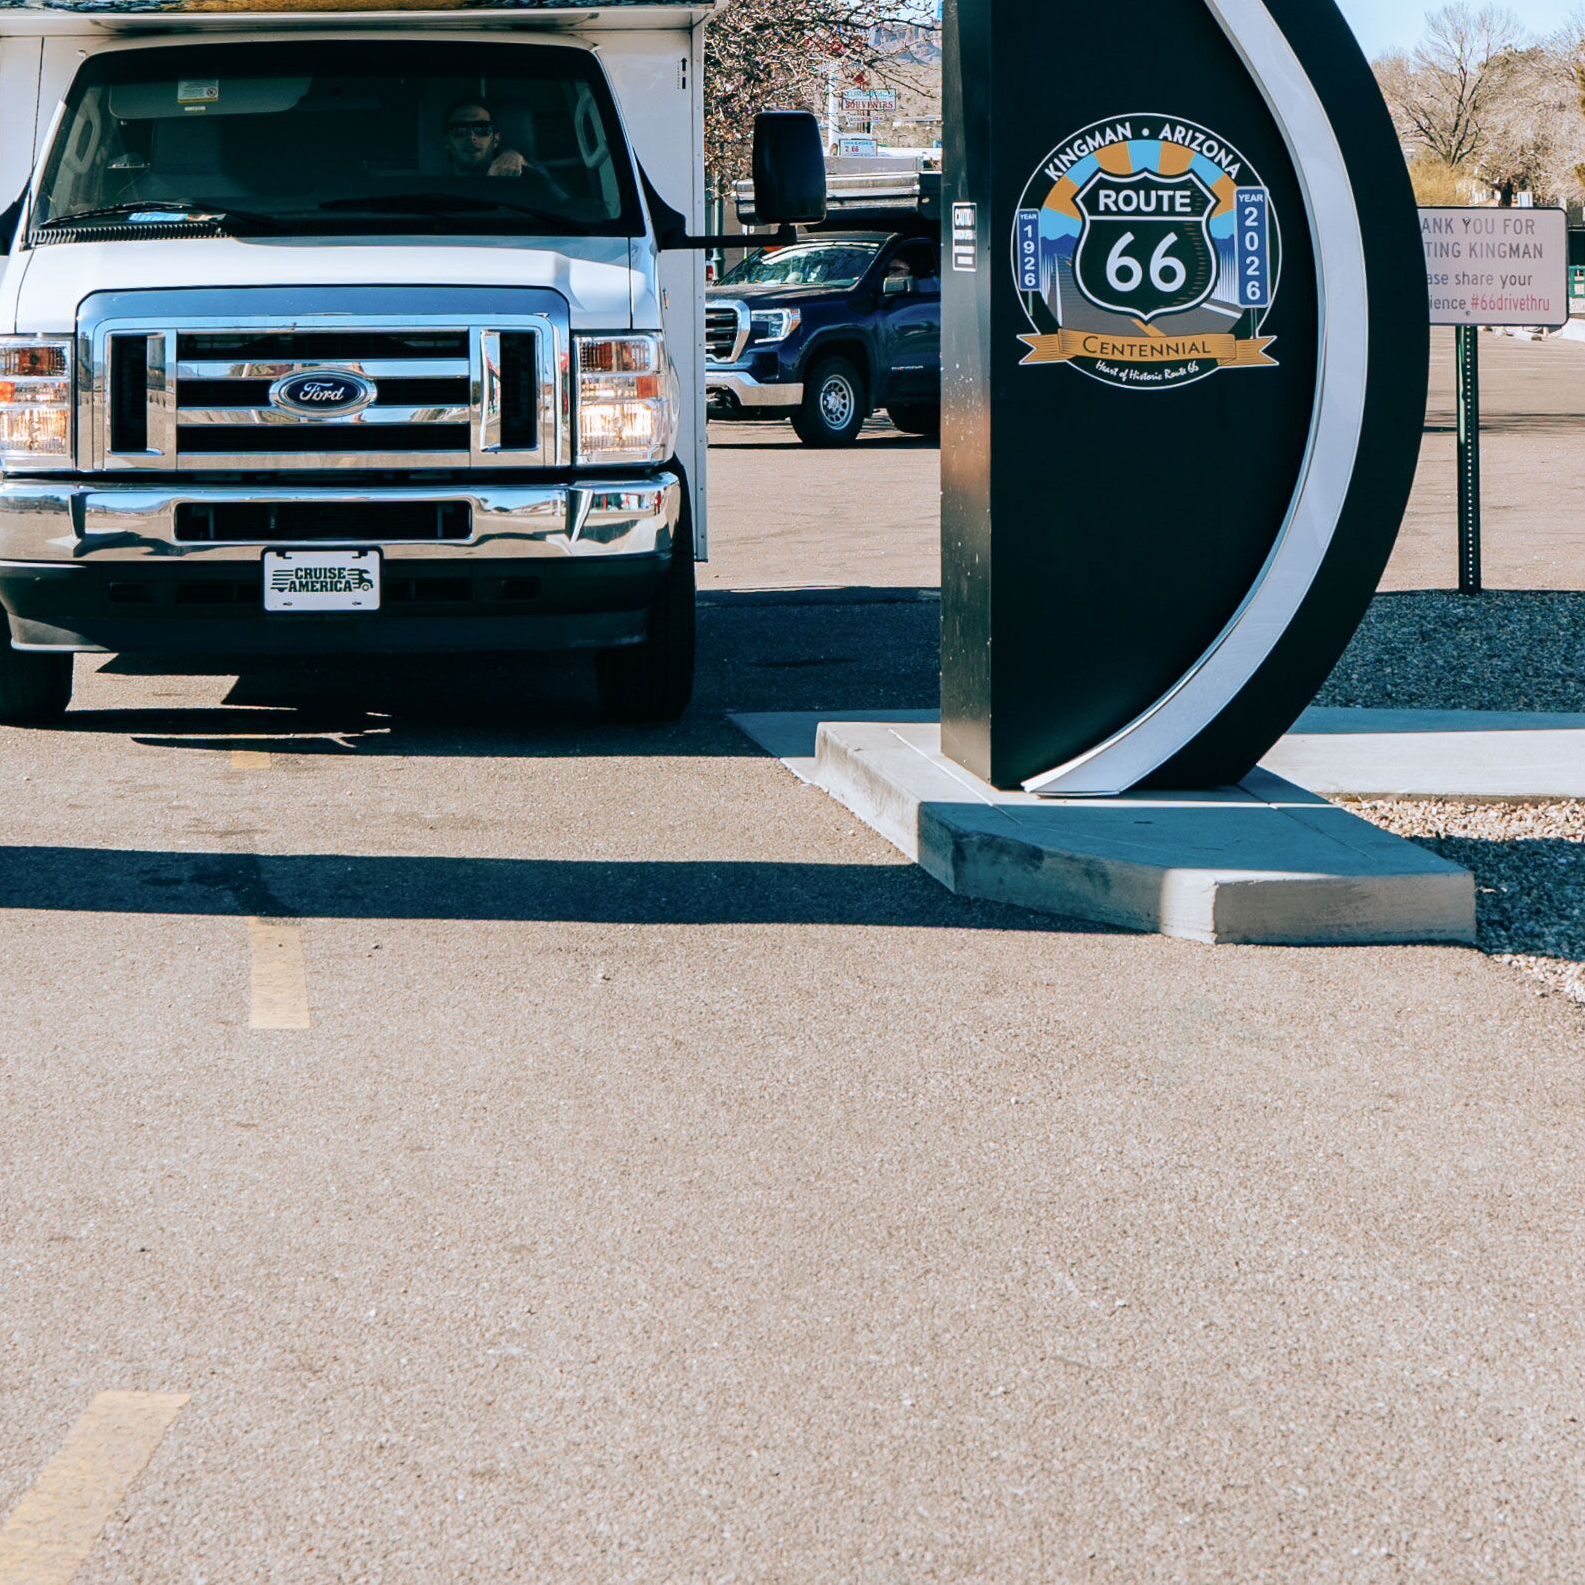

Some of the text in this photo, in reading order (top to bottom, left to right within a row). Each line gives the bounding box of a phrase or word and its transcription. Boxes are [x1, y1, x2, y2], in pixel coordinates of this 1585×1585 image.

[1044, 121, 1242, 183] KINGMAN ARIZONA
[1098, 189, 1192, 213] ROUTE
[1238, 193, 1264, 203] YEAR
[1020, 213, 1037, 221] YEAR
[1422, 218, 1535, 235] ANK YOU FOR
[1023, 225, 1036, 287] 1926
[1244, 207, 1261, 301] 2026
[1424, 242, 1543, 259] TING KINGMAN
[1105, 231, 1187, 293] 66
[1427, 271, 1533, 289] ase share your
[1471, 294, 1550, 311] #66drivethru
[1082, 335, 1212, 358] CENTENNIAL
[1119, 368, 1129, 382] of
[1129, 369, 1163, 381] Historic
[1164, 367, 1187, 379] Route
[1187, 360, 1200, 373] 66
[299, 381, 345, 401] Ford
[294, 567, 347, 580] CRUISE
[288, 579, 353, 593] AMERICA
